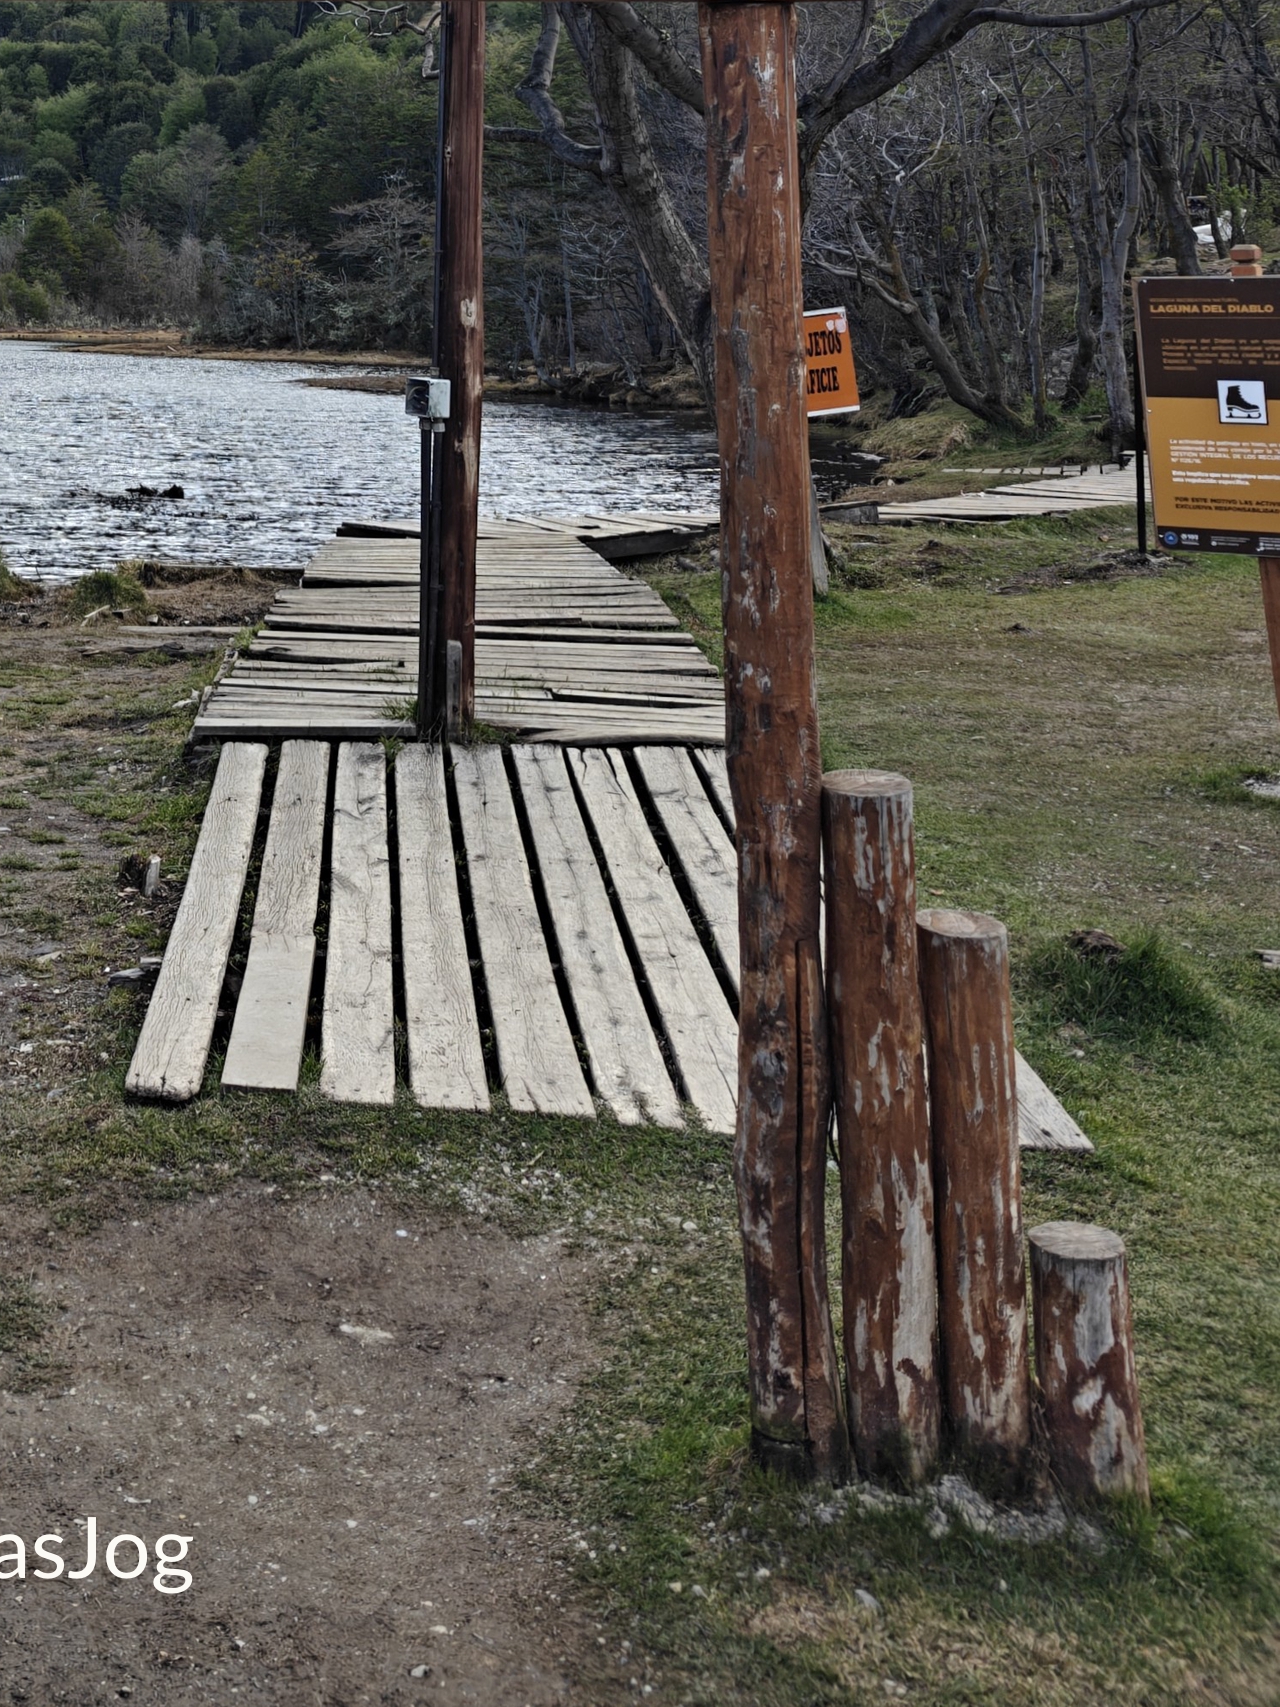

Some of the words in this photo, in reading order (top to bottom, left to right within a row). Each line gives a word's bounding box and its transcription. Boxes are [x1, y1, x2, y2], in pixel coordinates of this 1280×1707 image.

[1150, 304, 1200, 314] LAGUNA
[1202, 304, 1226, 314] DEL
[1227, 304, 1274, 314] DIABLO
[806, 329, 842, 357] JETOS
[806, 366, 839, 395] FICIE
